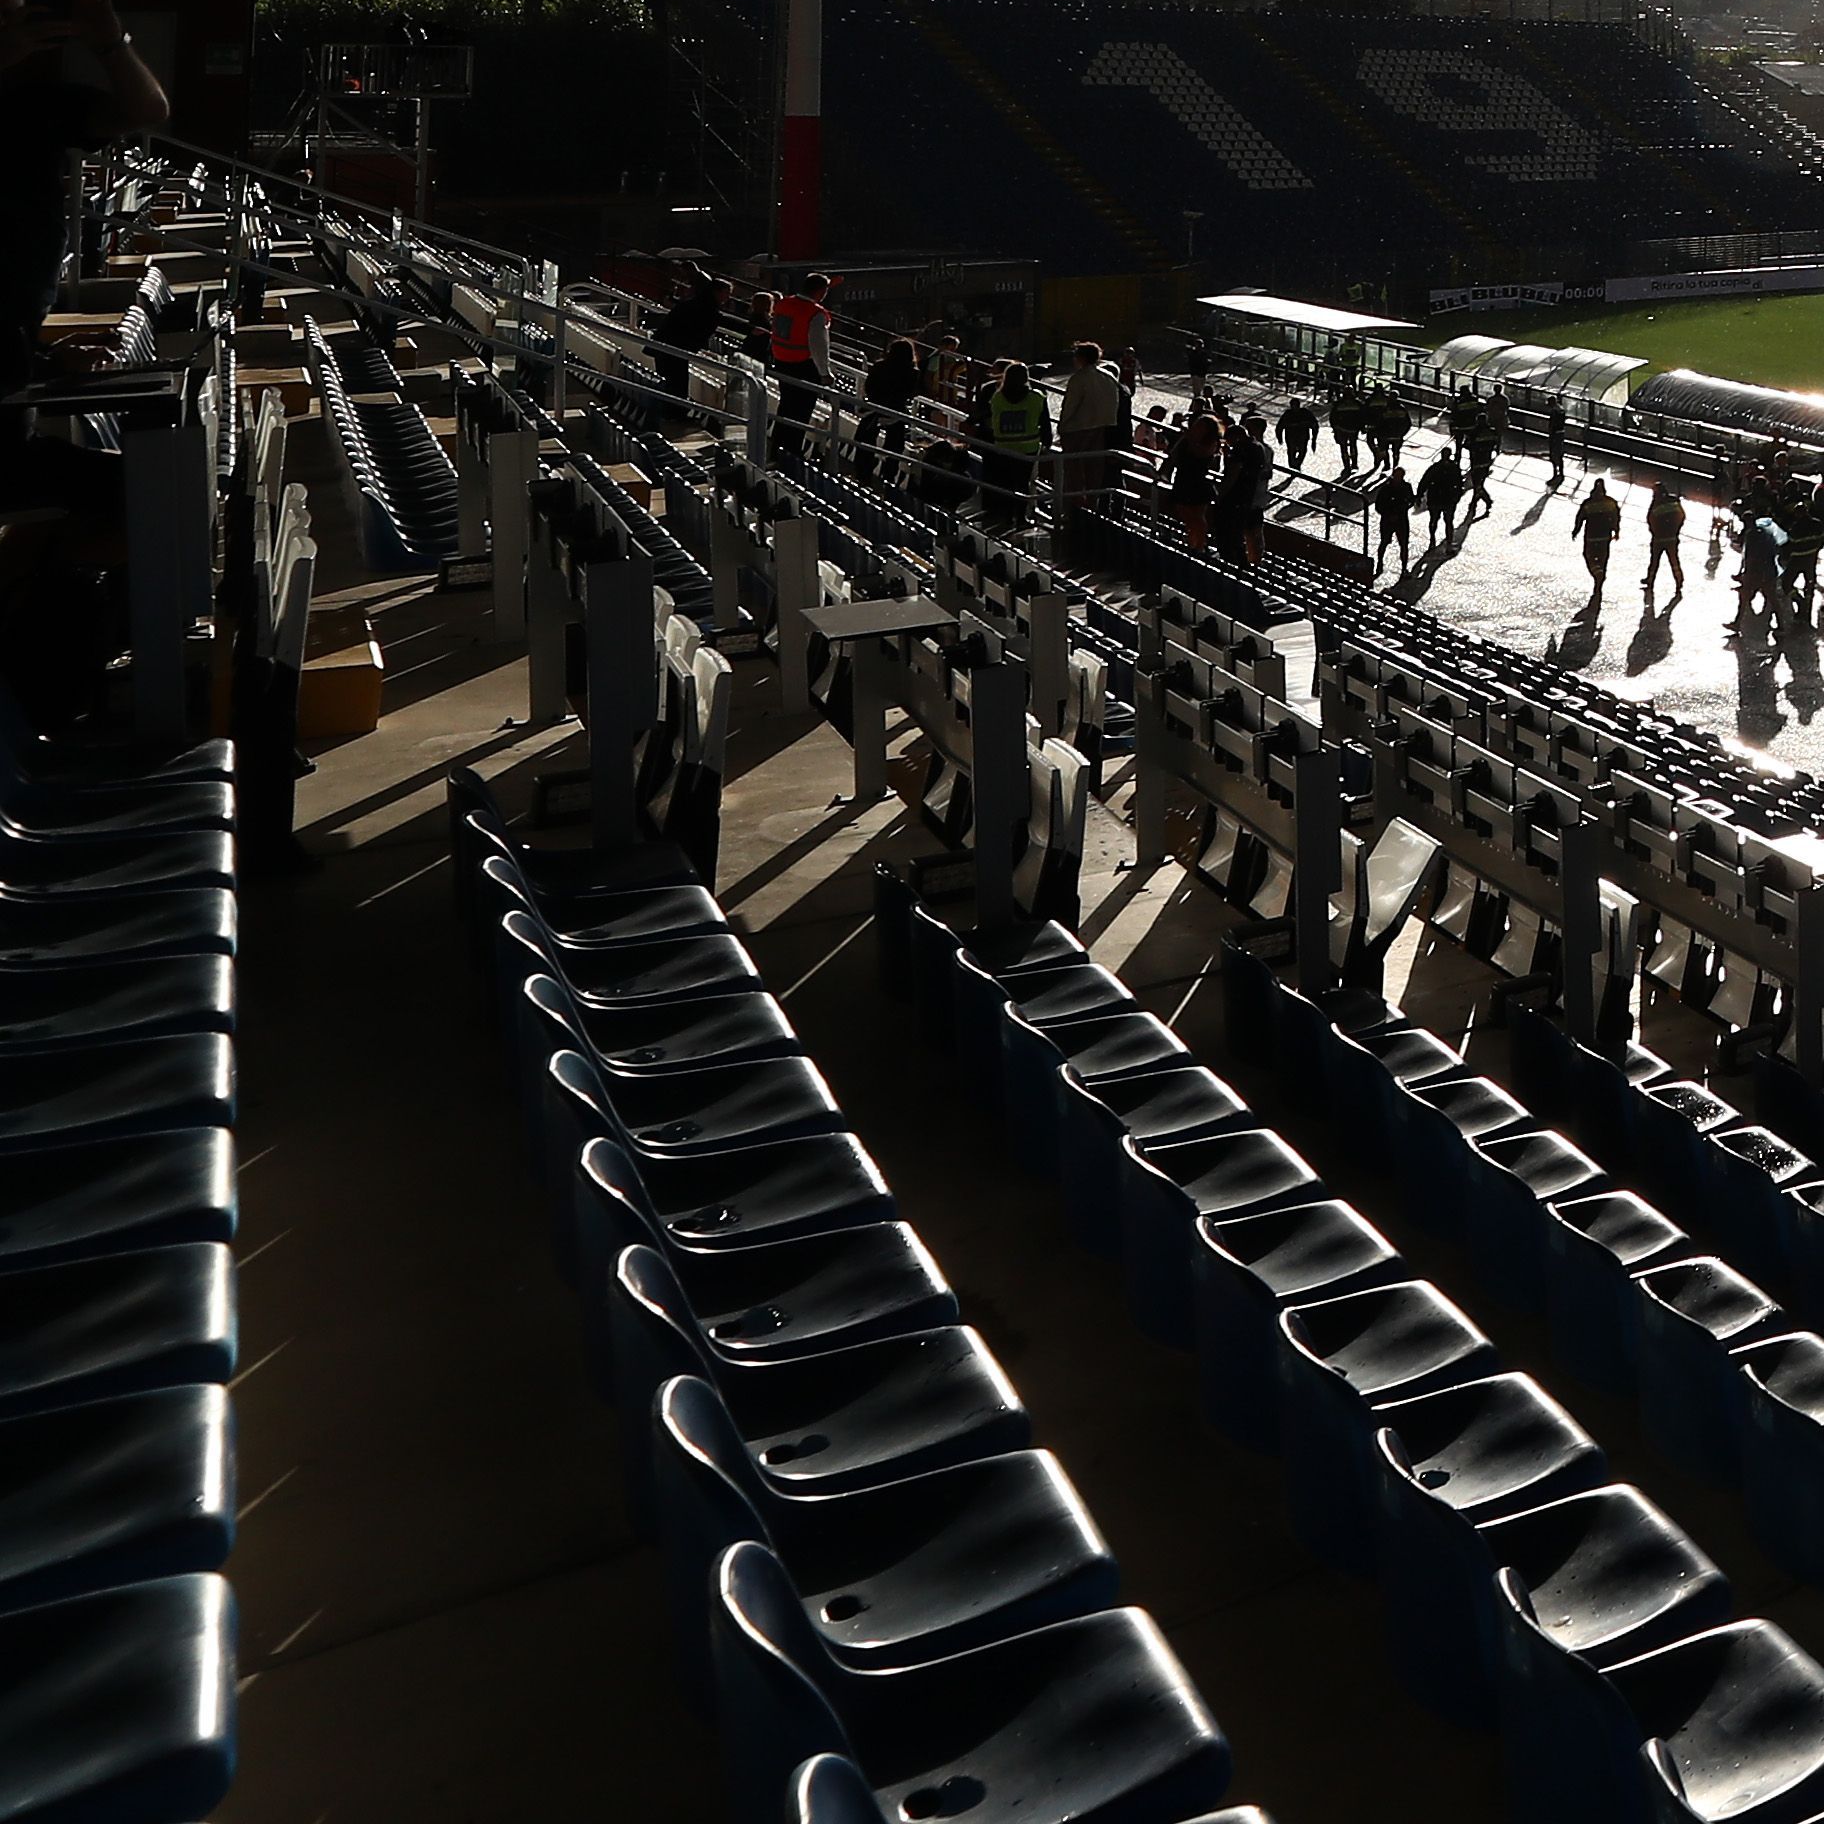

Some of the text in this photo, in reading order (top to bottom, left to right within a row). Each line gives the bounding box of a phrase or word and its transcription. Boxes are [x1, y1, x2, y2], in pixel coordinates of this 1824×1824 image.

[1651, 280, 1684, 292] Ritira
[1685, 280, 1696, 290] la
[1699, 279, 1718, 289] tua
[1719, 277, 1750, 289] copia
[1564, 286, 1606, 300] 00:00
